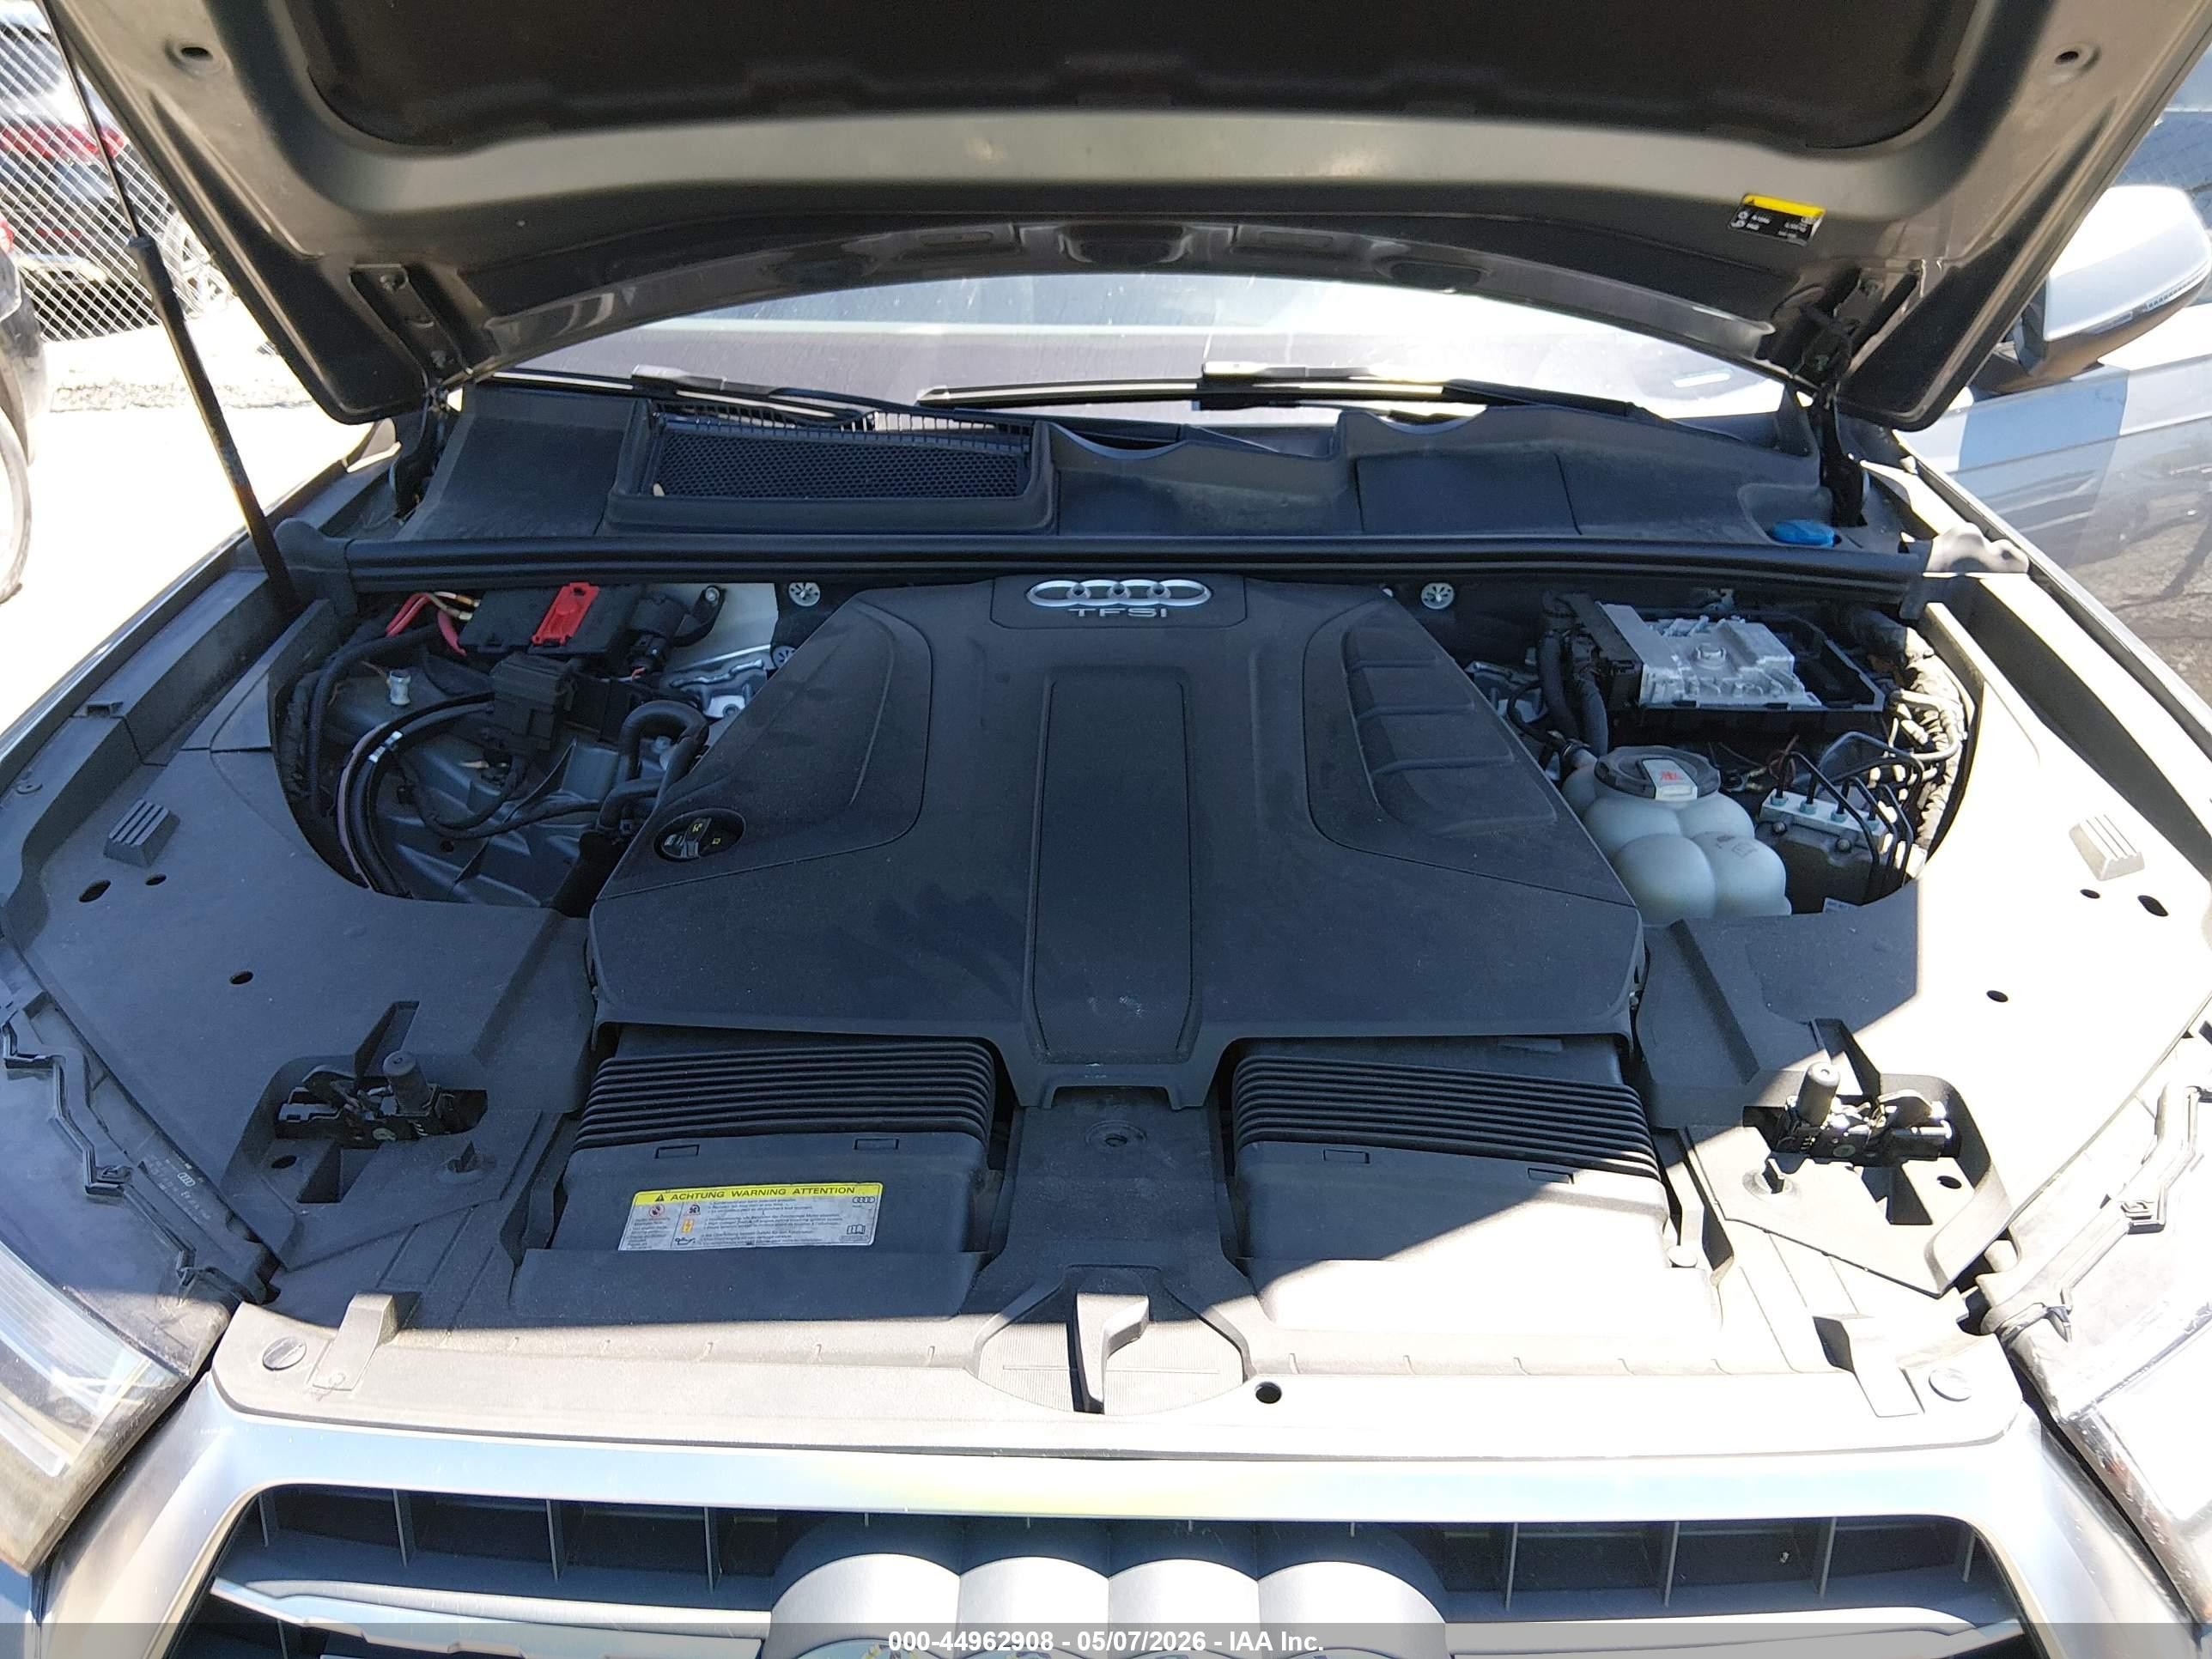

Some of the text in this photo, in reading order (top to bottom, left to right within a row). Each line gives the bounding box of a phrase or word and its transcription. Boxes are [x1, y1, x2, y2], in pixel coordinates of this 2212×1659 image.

[1068, 608, 1168, 617] TFSI
[671, 1187, 855, 1201] ACHTUNG WARNING ATTENTION
